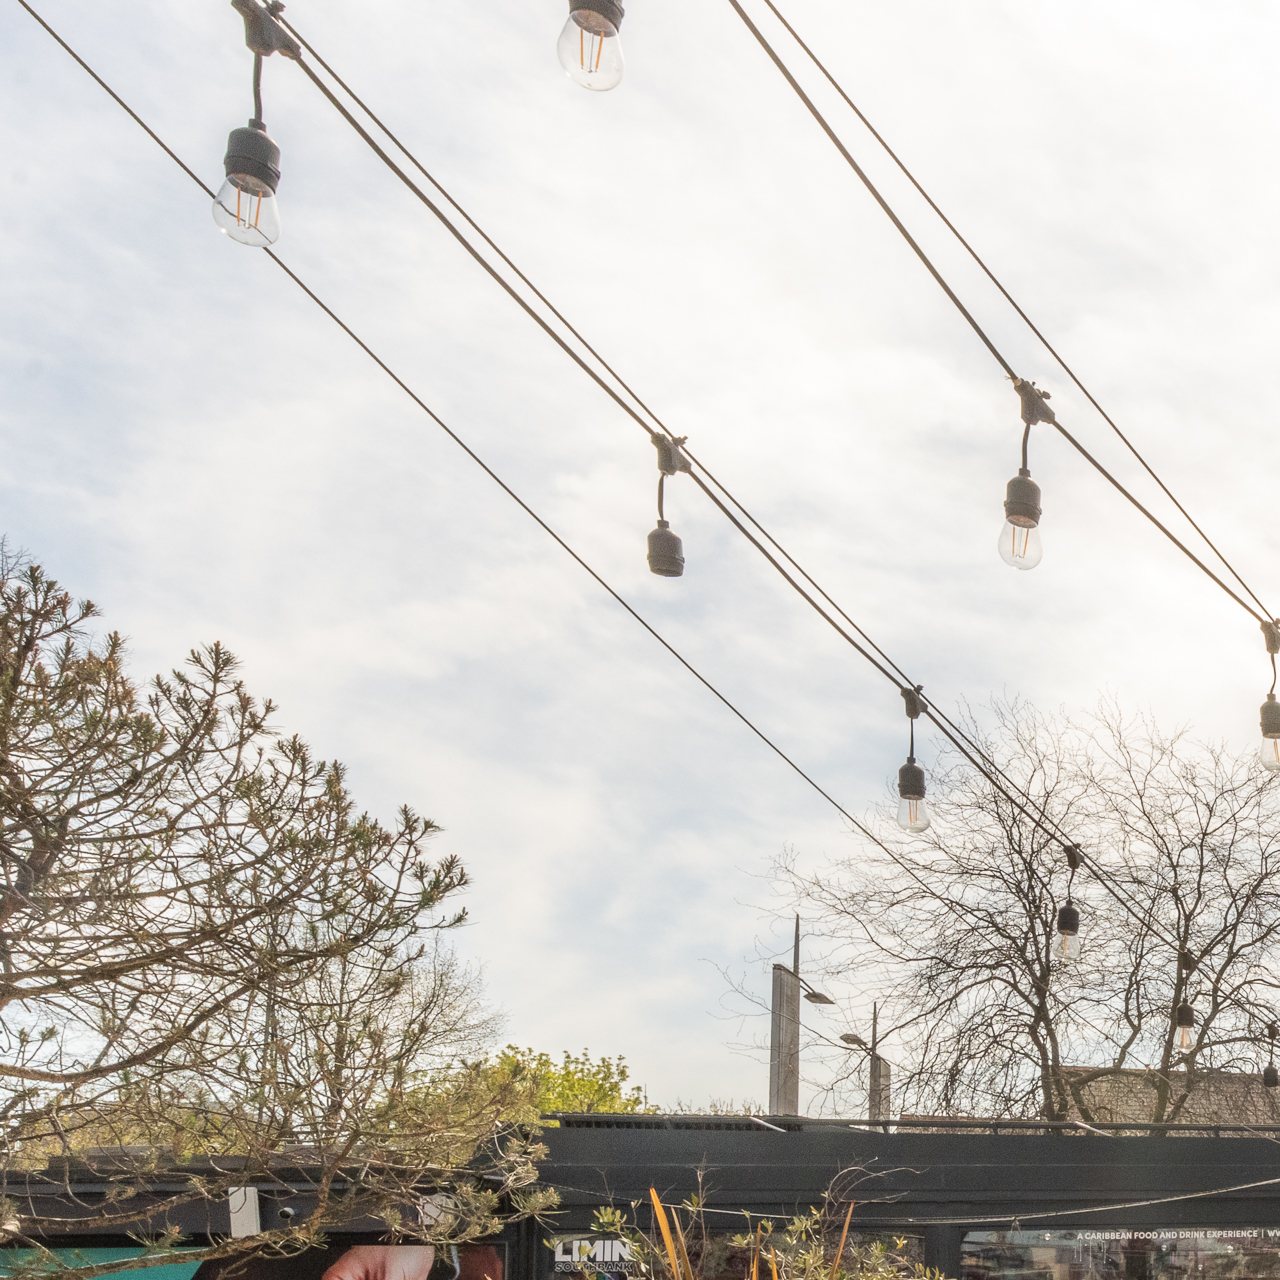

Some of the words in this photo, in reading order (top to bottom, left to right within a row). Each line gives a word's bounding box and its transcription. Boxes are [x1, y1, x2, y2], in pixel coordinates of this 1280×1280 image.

[1077, 1232, 1084, 1240] A
[1084, 1232, 1133, 1240] CARIBBEAN
[1133, 1231, 1159, 1239] FOOD
[1159, 1231, 1178, 1239] AND
[1179, 1230, 1205, 1239] DRINK
[1206, 1229, 1258, 1238] EXPERIENCE
[554, 1240, 632, 1262] LIMIN
